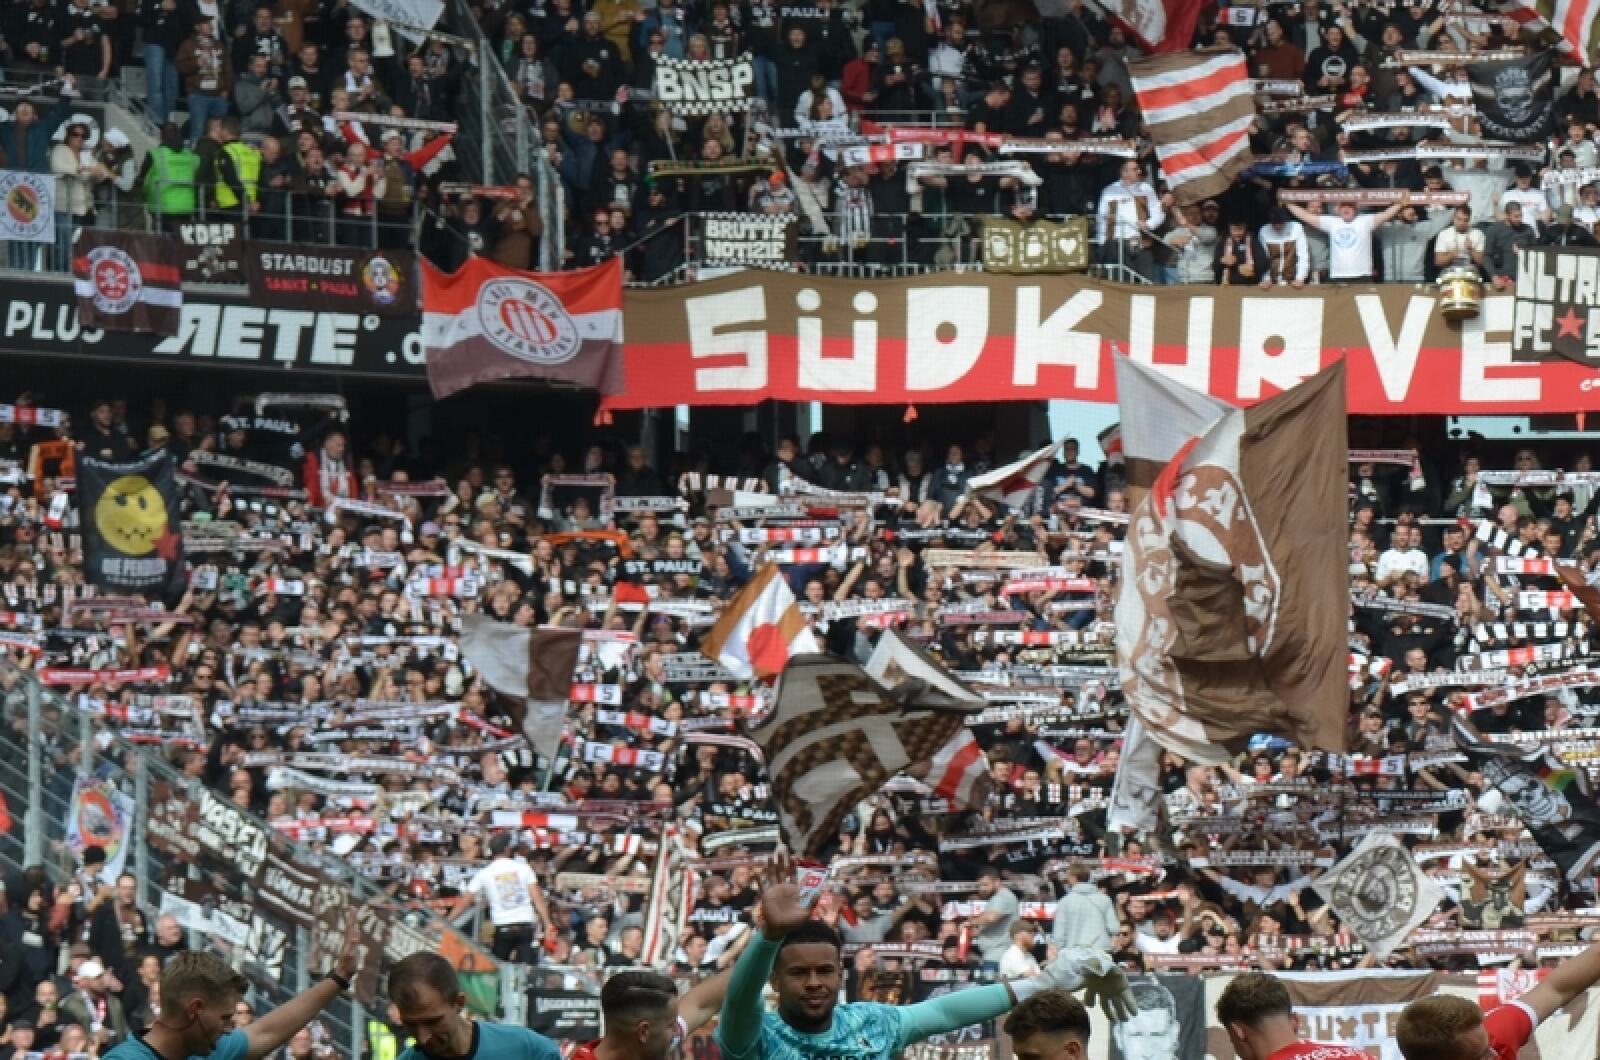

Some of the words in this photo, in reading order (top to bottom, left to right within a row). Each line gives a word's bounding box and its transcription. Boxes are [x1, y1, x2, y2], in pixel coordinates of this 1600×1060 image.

[658, 63, 753, 101] BNSP
[706, 220, 786, 239] BRUTTE
[706, 241, 785, 259] NOTIZIE
[260, 252, 354, 276] STARDUST
[1513, 300, 1553, 352] FC
[625, 560, 647, 574] ST.
[655, 560, 701, 574] PAULI
[1298, 1010, 1399, 1041] BUXTE
